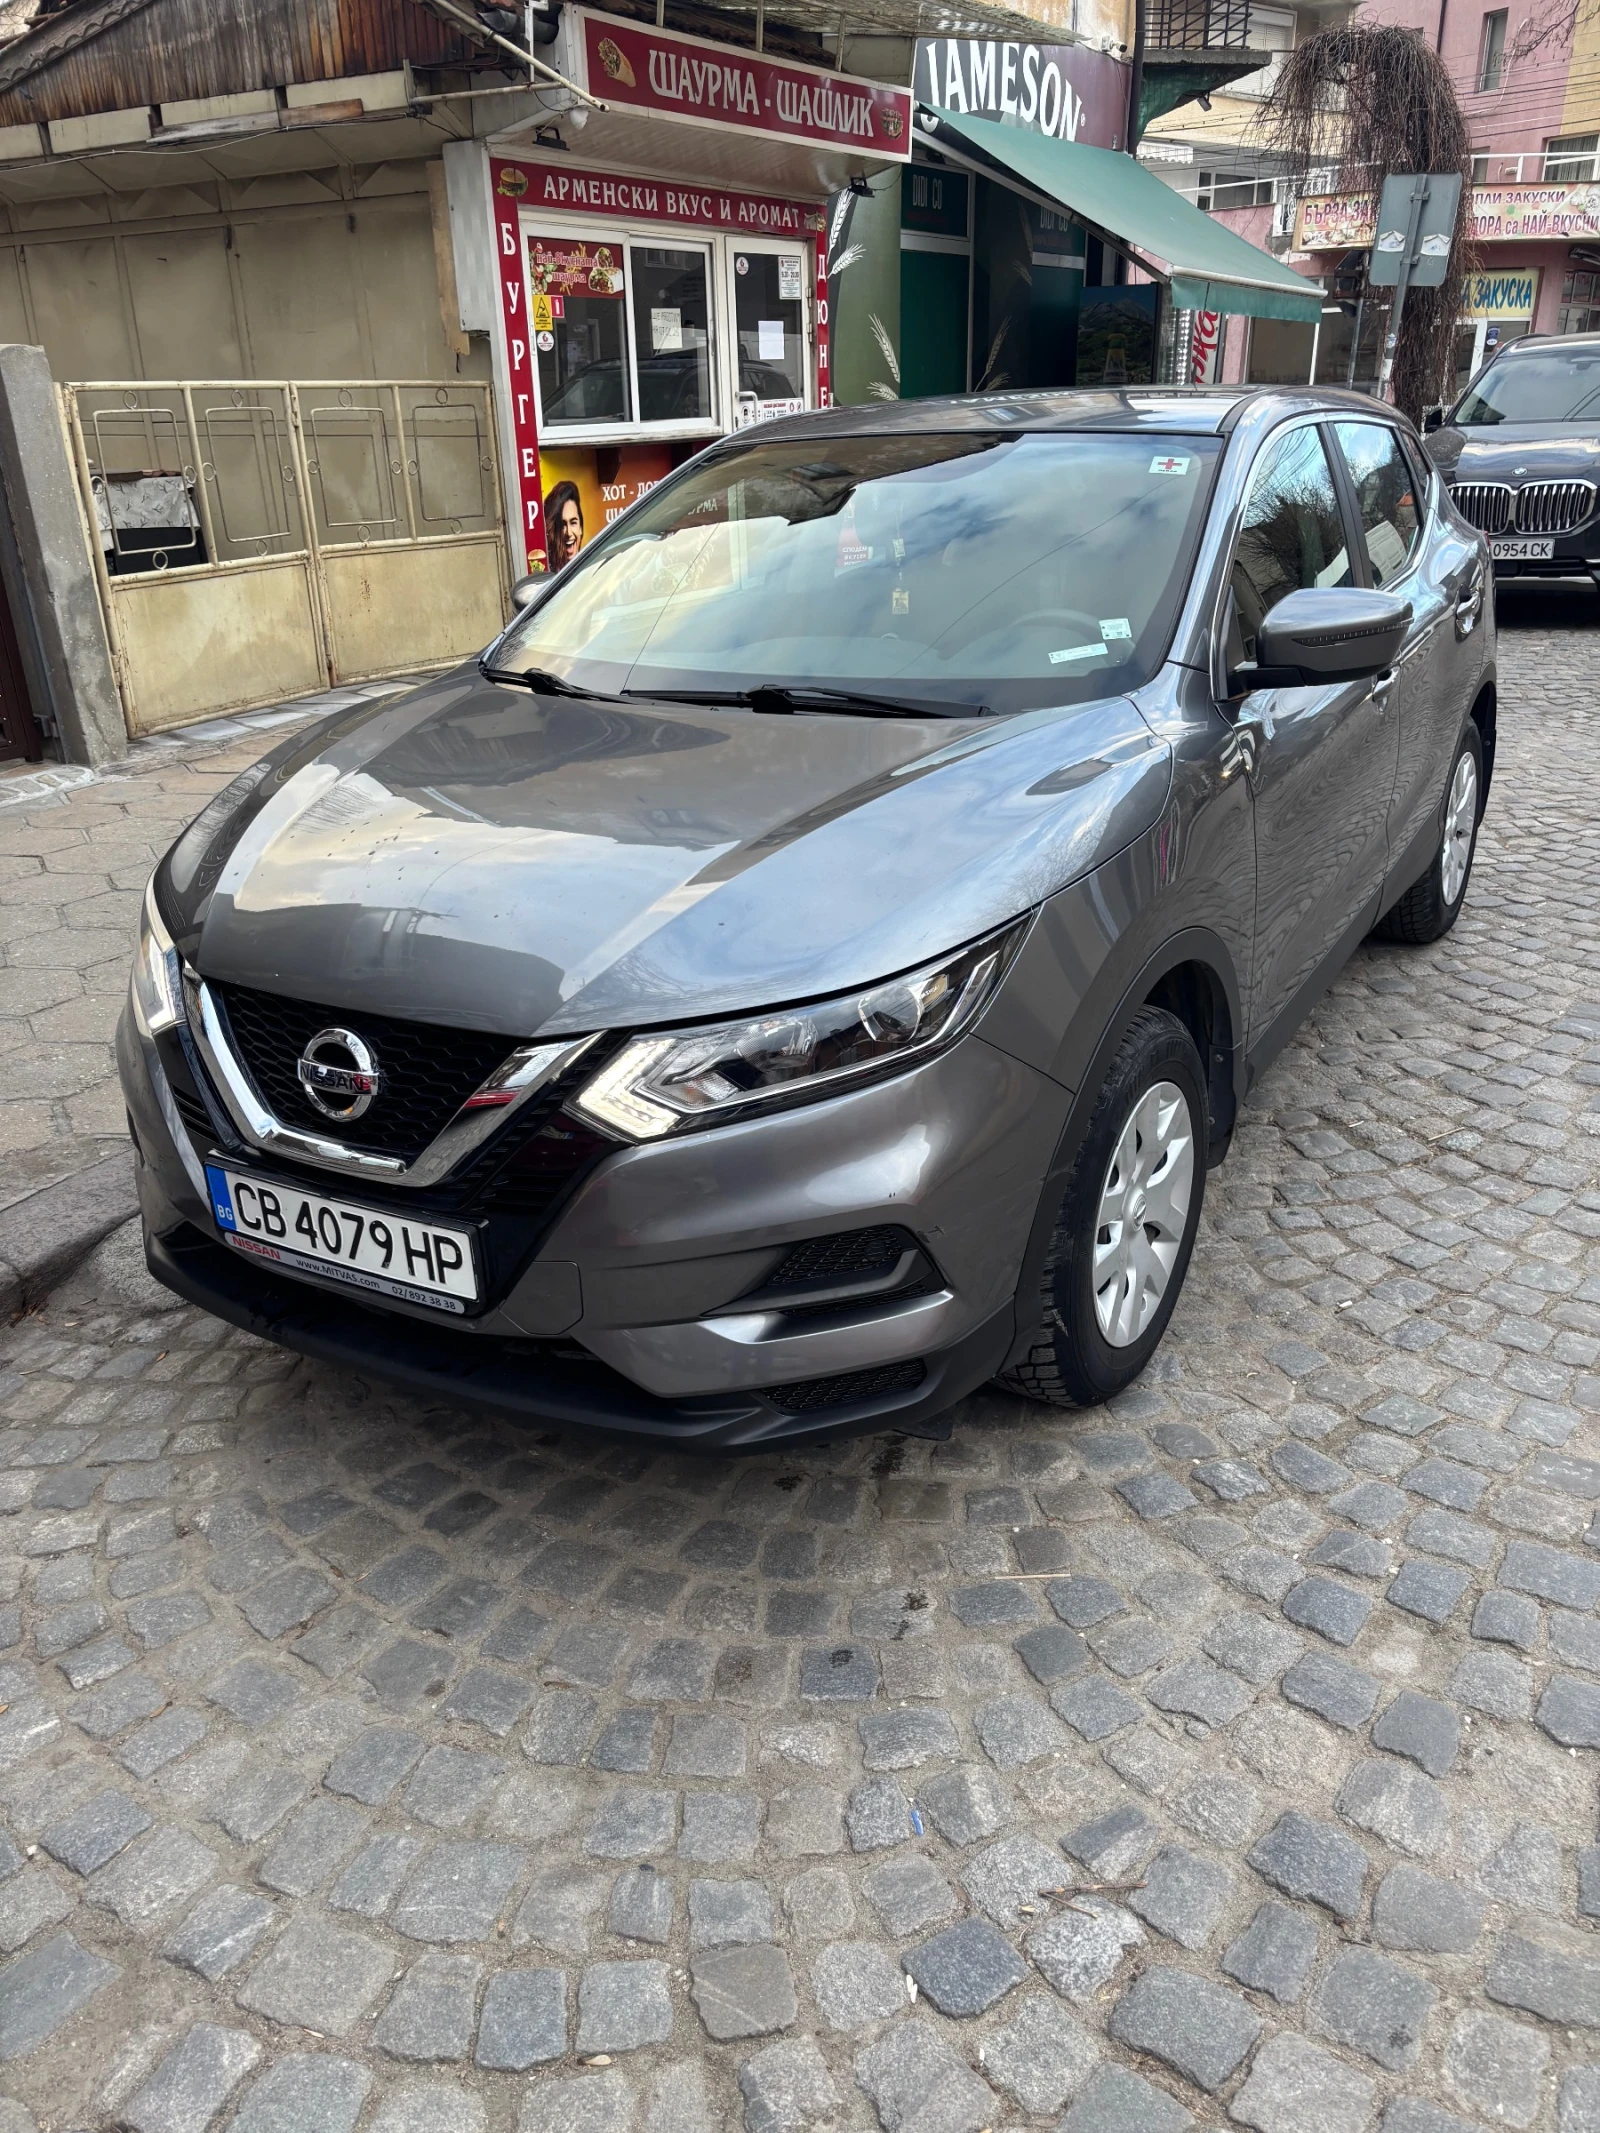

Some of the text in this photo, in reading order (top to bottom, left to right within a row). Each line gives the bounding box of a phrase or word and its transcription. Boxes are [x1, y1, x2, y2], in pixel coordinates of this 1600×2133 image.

[648, 49, 760, 116] ШАУРМА
[776, 76, 875, 138] ШАШЛИК
[920, 39, 1083, 142] JAMESON
[543, 173, 799, 229] АРМЕНСКИ ВКУС И АРОМАТ
[912, 174, 943, 210] DIDI CO
[1506, 190, 1566, 204] ЗАКУСКИ
[1304, 202, 1348, 226] БЪРЗА
[1505, 219, 1518, 234] са
[1522, 209, 1600, 234] НАЙ-ВКУСНИ
[1474, 277, 1533, 310] ЗАКУСКА
[602, 484, 627, 502] ХОТ
[1493, 543, 1528, 557] 0954
[299, 1063, 364, 1092] NISSAN
[218, 1203, 234, 1222] BG
[295, 1200, 394, 1269] 4079
[232, 1235, 281, 1261] NISSAN
[296, 1257, 381, 1290] www.MITVAS.com
[427, 1294, 442, 1308] 38
[443, 1298, 457, 1311] 38
